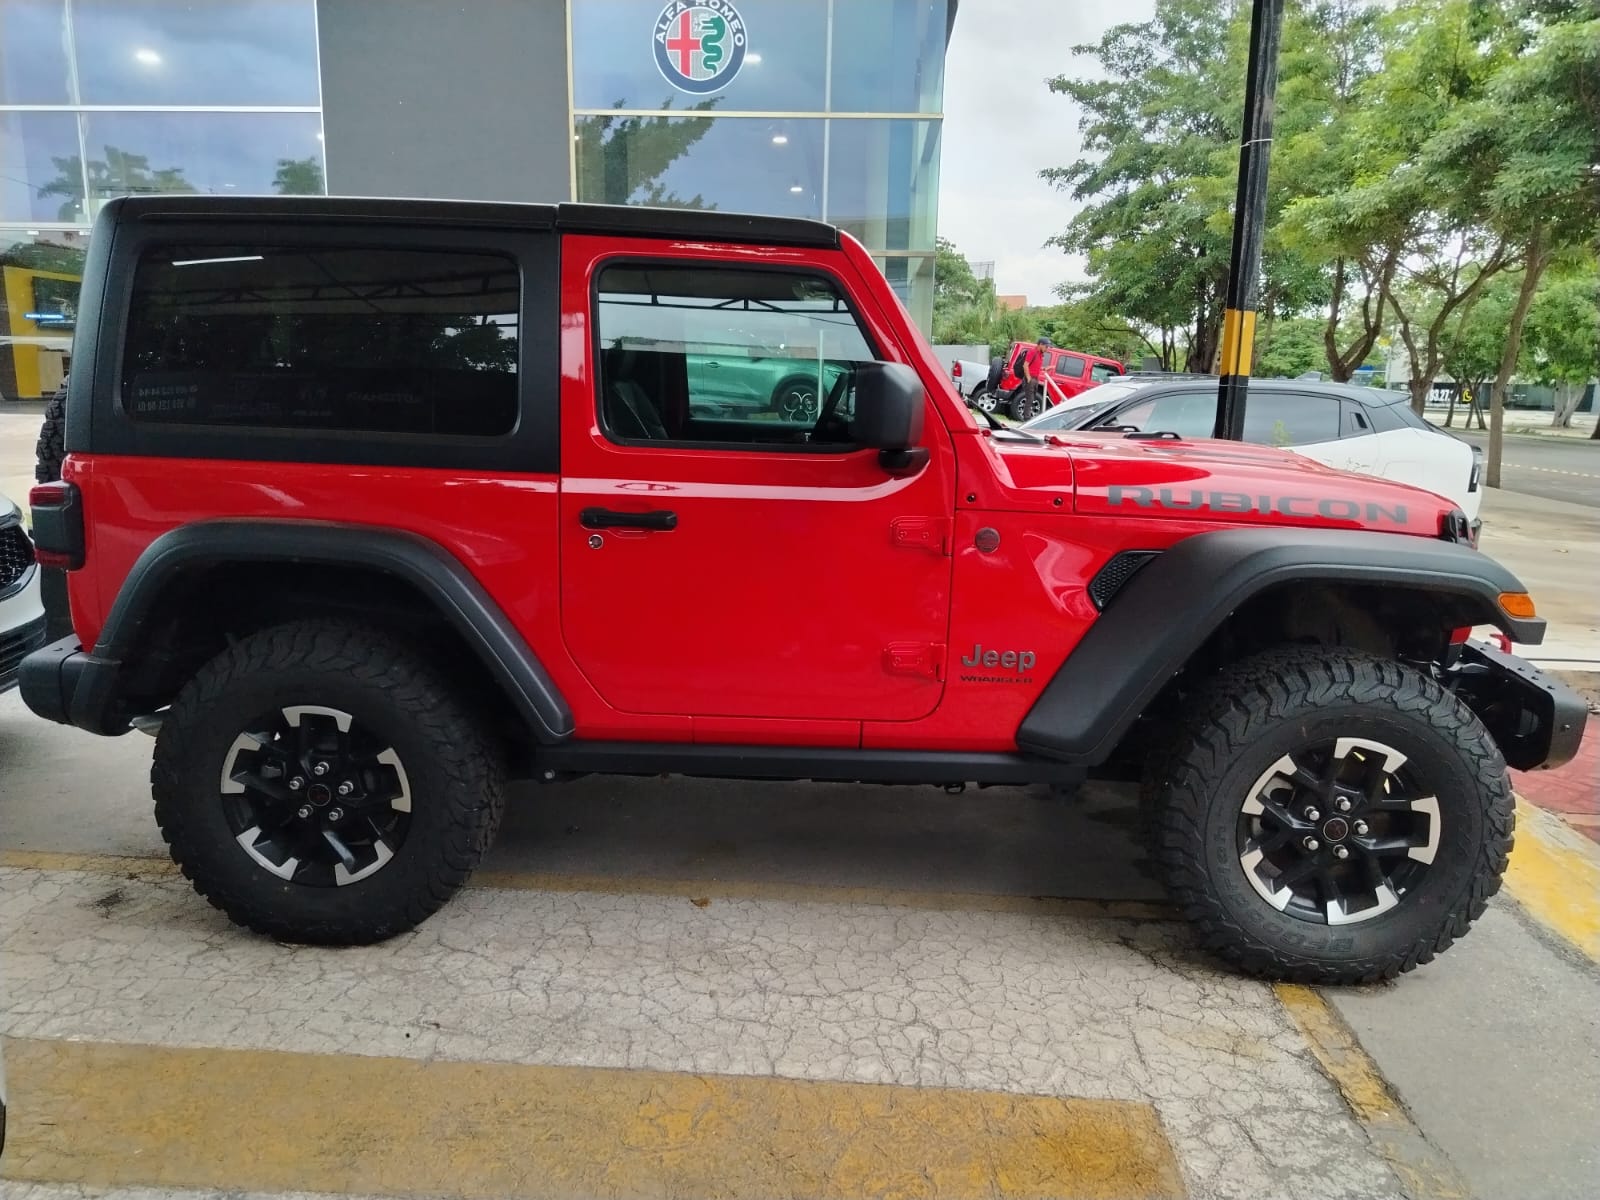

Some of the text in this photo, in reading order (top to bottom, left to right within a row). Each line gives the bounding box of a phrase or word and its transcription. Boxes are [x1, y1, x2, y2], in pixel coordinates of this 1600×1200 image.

[655, 1, 687, 45] ALFA
[1107, 485, 1408, 524] RUBICON
[961, 644, 1036, 673] Jeep
[960, 675, 1032, 683] WRANGLER
